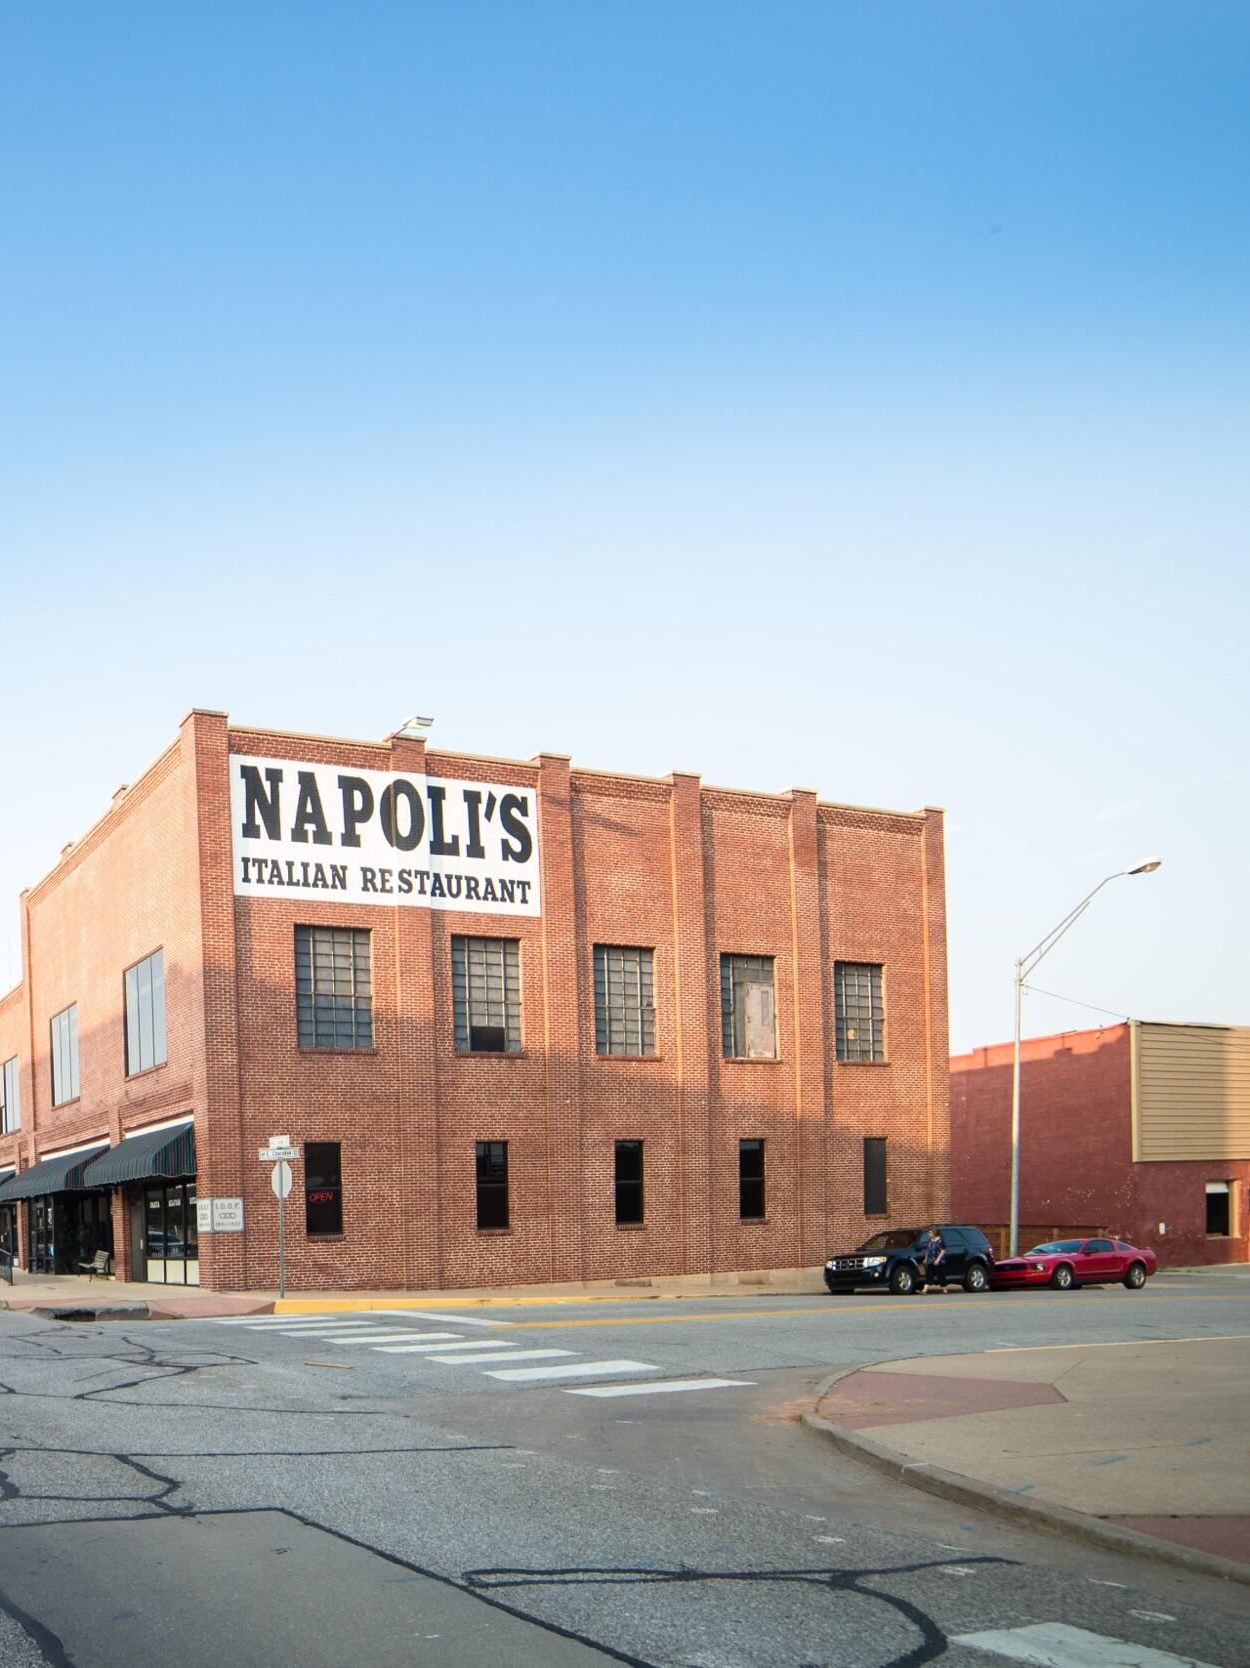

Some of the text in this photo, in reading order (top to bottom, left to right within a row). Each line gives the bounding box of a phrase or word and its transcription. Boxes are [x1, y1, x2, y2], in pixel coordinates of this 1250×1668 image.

[240, 765, 532, 864] NAPOLI'S
[241, 856, 532, 905] ITALIAN RESTAURANT
[310, 1192, 333, 1201] OPEN
